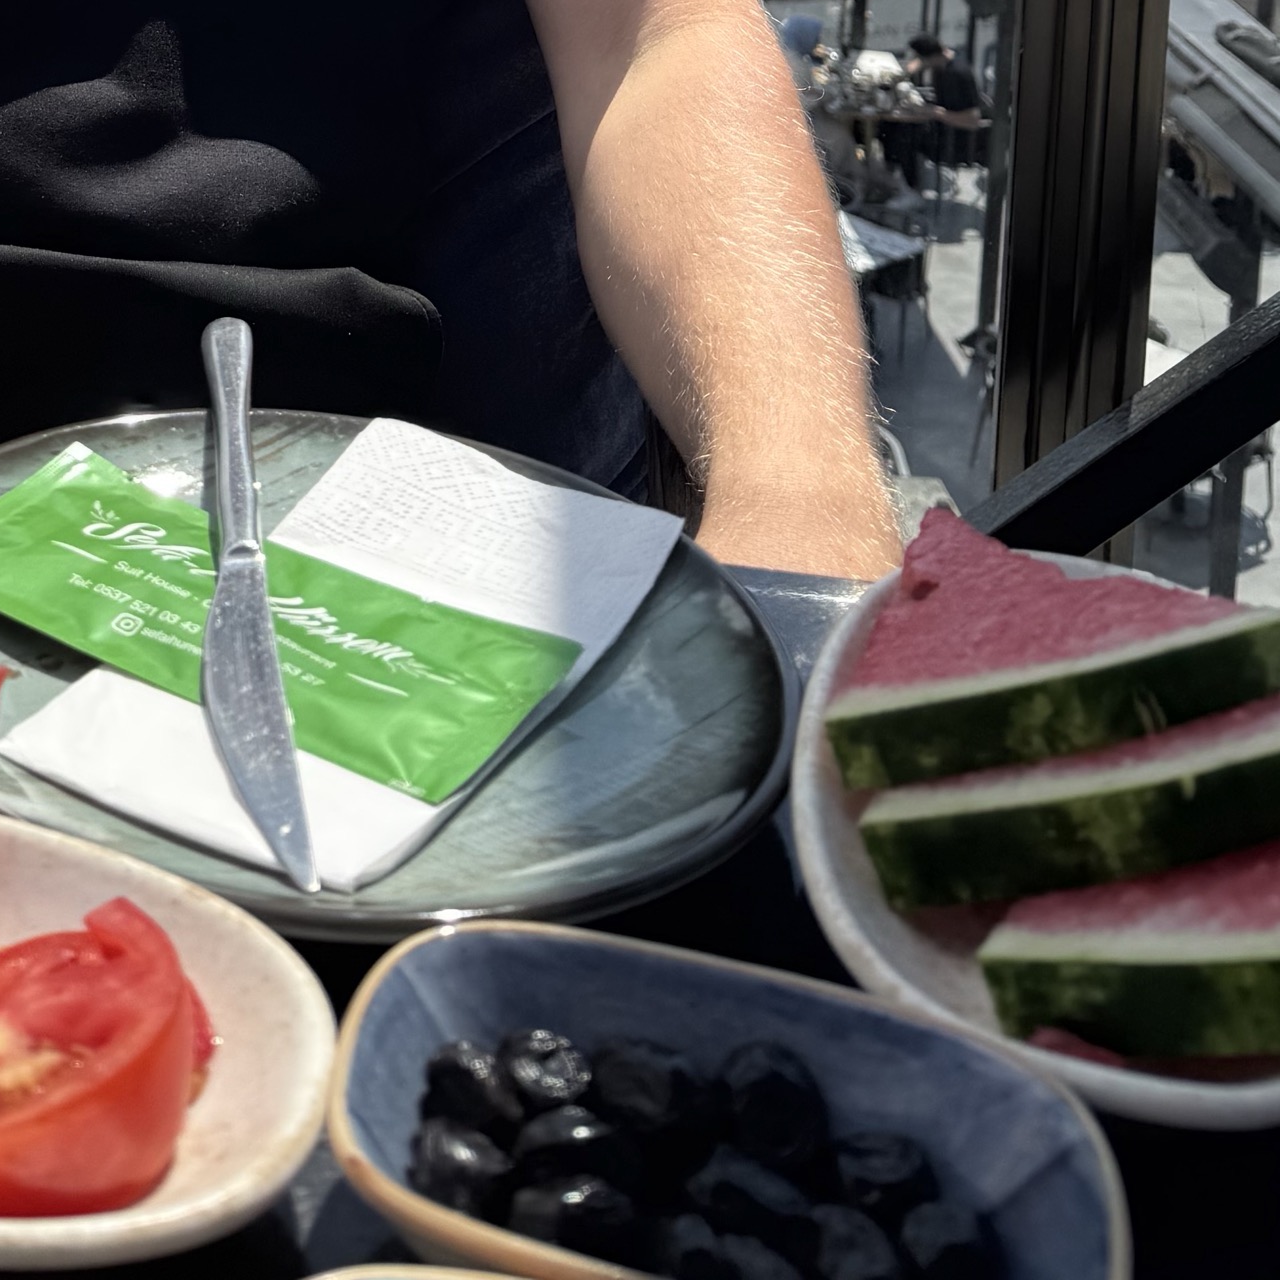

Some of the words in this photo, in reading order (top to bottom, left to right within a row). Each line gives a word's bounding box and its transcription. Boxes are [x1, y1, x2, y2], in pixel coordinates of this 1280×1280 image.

[113, 560, 144, 578] Suit
[143, 572, 191, 599] House
[93, 583, 133, 603] 0537
[129, 599, 158, 617] 521
